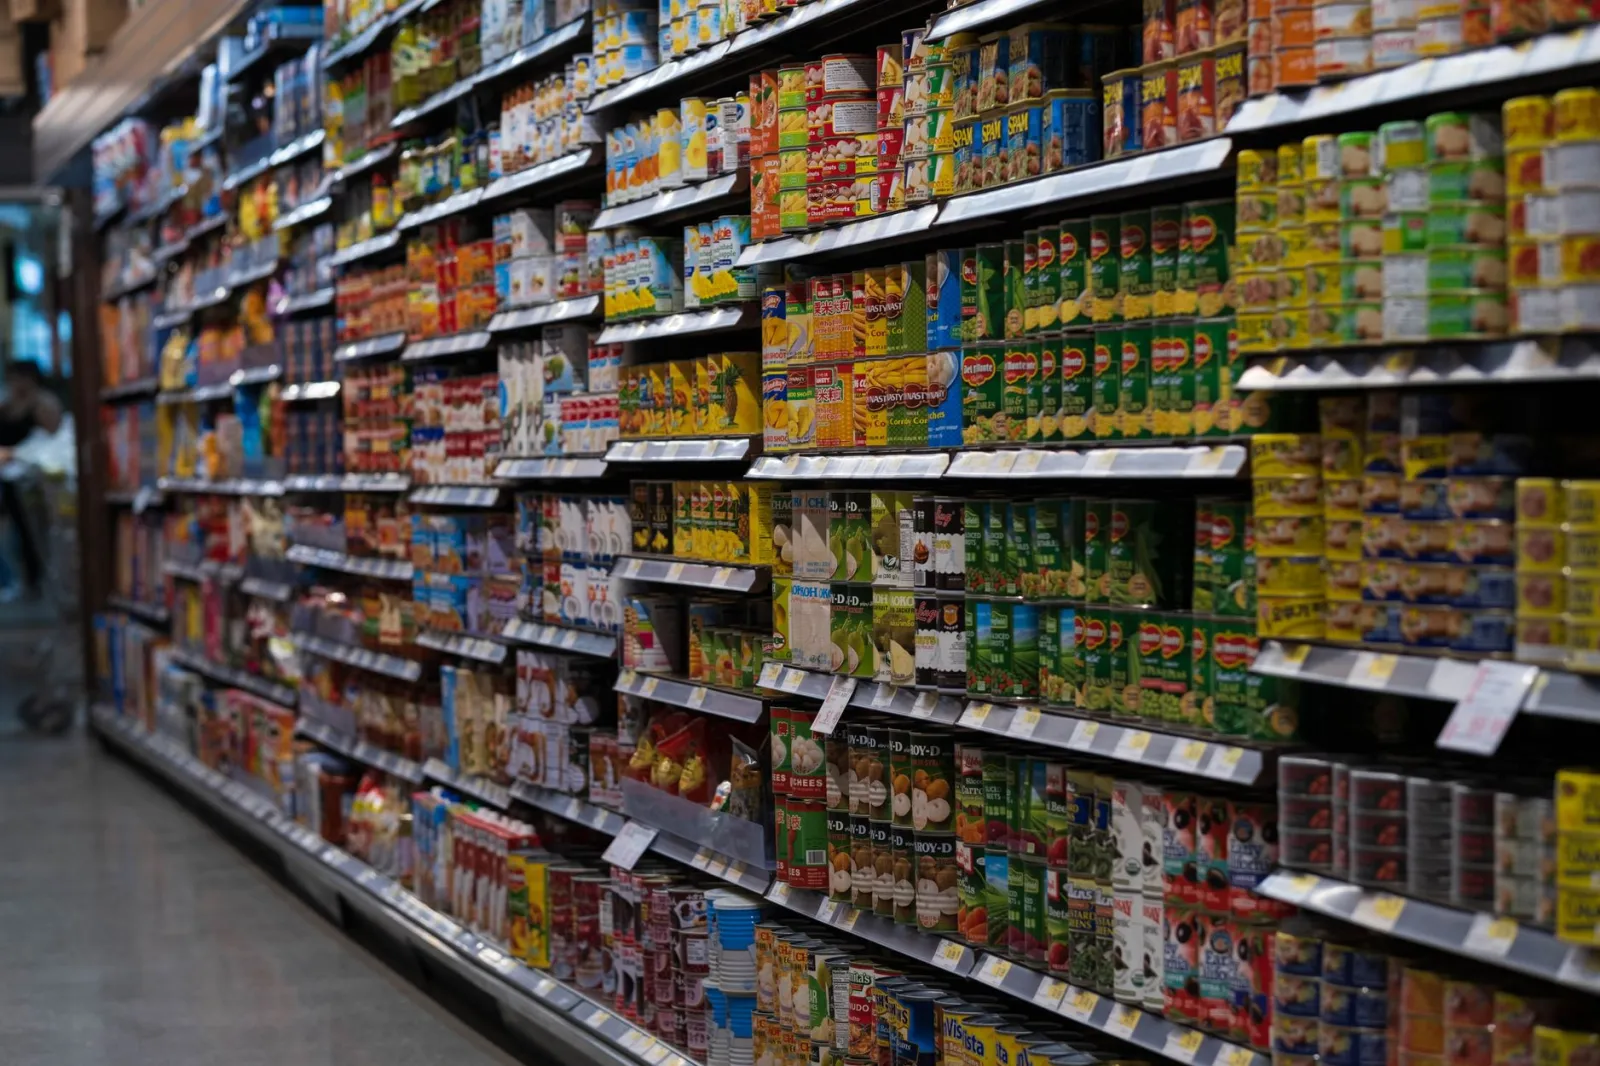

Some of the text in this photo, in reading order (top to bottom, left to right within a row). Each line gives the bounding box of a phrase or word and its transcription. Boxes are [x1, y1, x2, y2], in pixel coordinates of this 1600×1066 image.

[1178, 64, 1202, 90] SPAM
[1216, 52, 1243, 80] SPAM
[1142, 75, 1166, 103] SPAM
[982, 119, 1001, 143] SPAM
[1008, 112, 1029, 136] SPAM
[953, 126, 973, 149] SPAM
